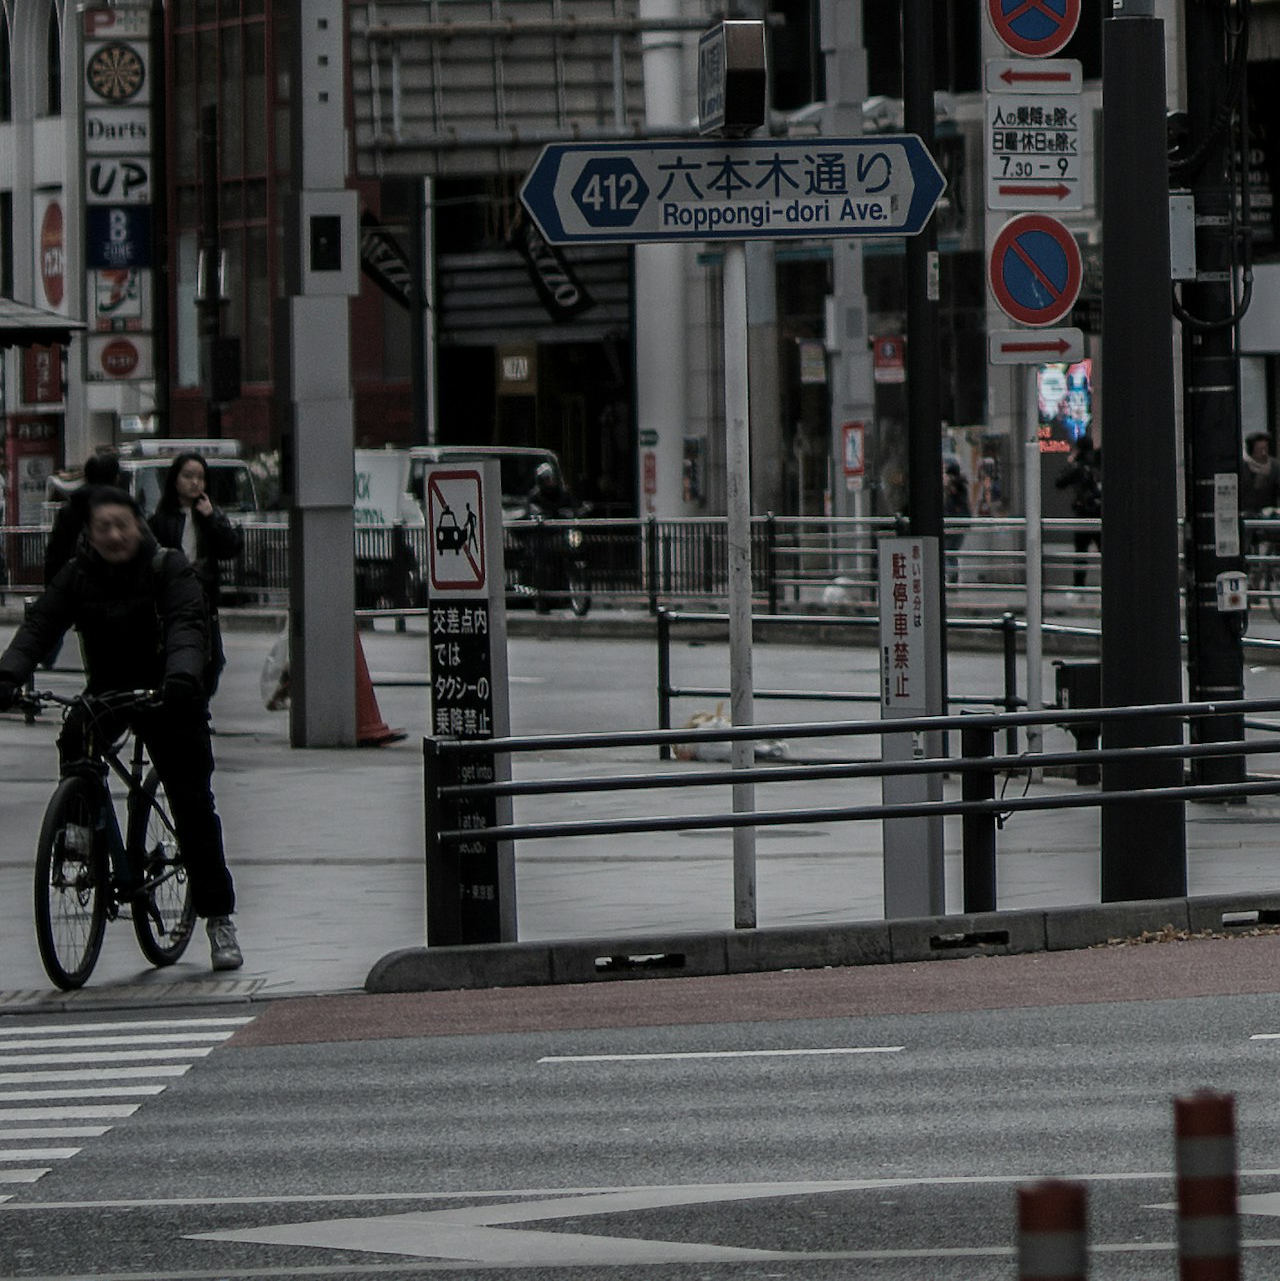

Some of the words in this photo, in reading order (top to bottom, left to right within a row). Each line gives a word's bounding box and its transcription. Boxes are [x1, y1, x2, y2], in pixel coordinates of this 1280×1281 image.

[87, 119, 147, 139] Darts
[89, 162, 148, 197] UP
[657, 152, 893, 201] 六本木通り
[581, 173, 640, 212] 412
[663, 199, 829, 231] Roppongi-dori
[840, 201, 888, 222] Ave.
[432, 606, 488, 636] 交差点内
[892, 553, 910, 699] 駐停車禁止
[433, 641, 462, 667] では
[434, 674, 491, 701] タクシーの
[435, 706, 492, 736] 乗降禁止
